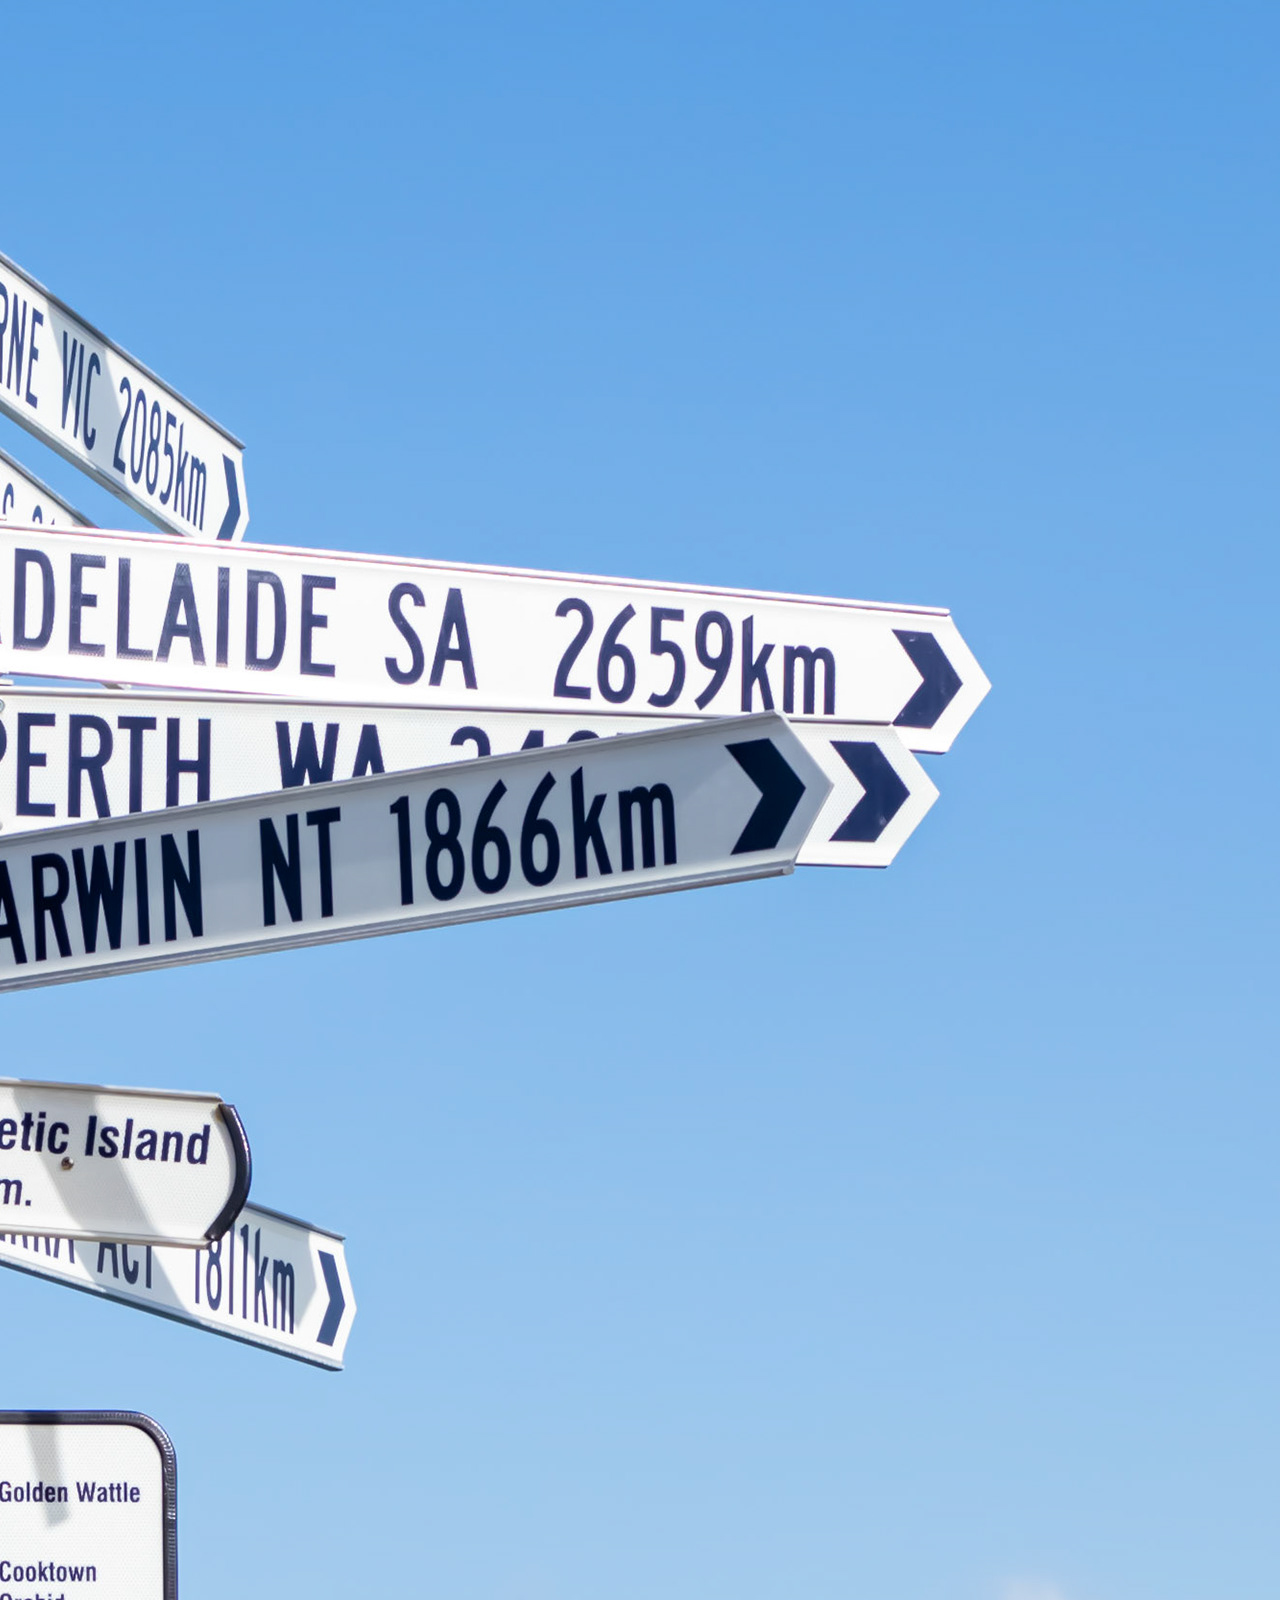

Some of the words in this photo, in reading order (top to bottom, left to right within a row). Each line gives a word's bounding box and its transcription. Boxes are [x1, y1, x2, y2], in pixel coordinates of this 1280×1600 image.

[61, 330, 101, 451] VIC
[113, 376, 207, 532] 2085km
[385, 581, 479, 691] SA
[553, 597, 838, 716] 2659km
[261, 807, 342, 927] NT
[389, 766, 678, 907] 1866km
[84, 1115, 210, 1165] Island
[75, 1482, 141, 1502] Wattle
